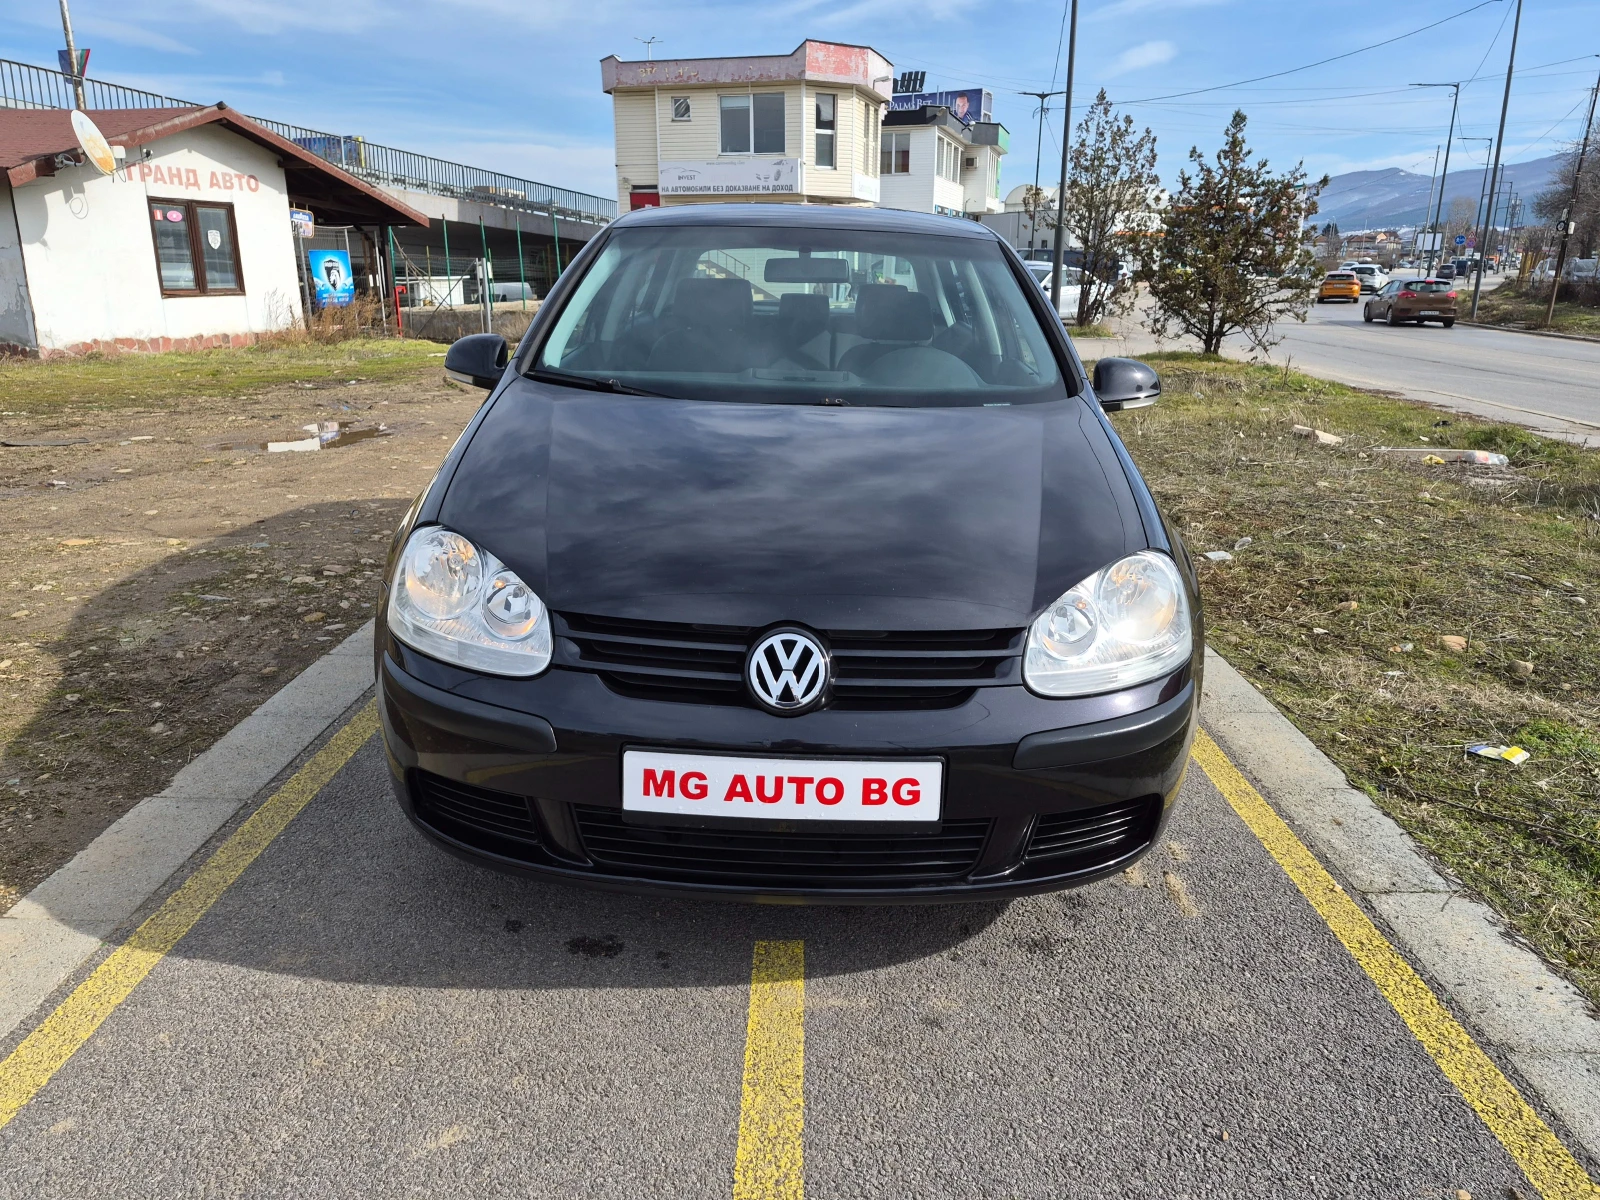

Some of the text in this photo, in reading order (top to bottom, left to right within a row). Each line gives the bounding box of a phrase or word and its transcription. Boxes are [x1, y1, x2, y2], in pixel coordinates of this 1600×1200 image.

[889, 101, 915, 110] PALMS
[125, 161, 260, 193] ГРАНД АВТО
[670, 185, 711, 193] АВТОМОБИЛИ
[712, 185, 723, 193] БЕЗ
[725, 184, 760, 193] ДОКАЗВАНЕ
[762, 184, 770, 192] НА
[771, 184, 793, 192] ДОХОД
[642, 768, 922, 806] MG AUTO BG
